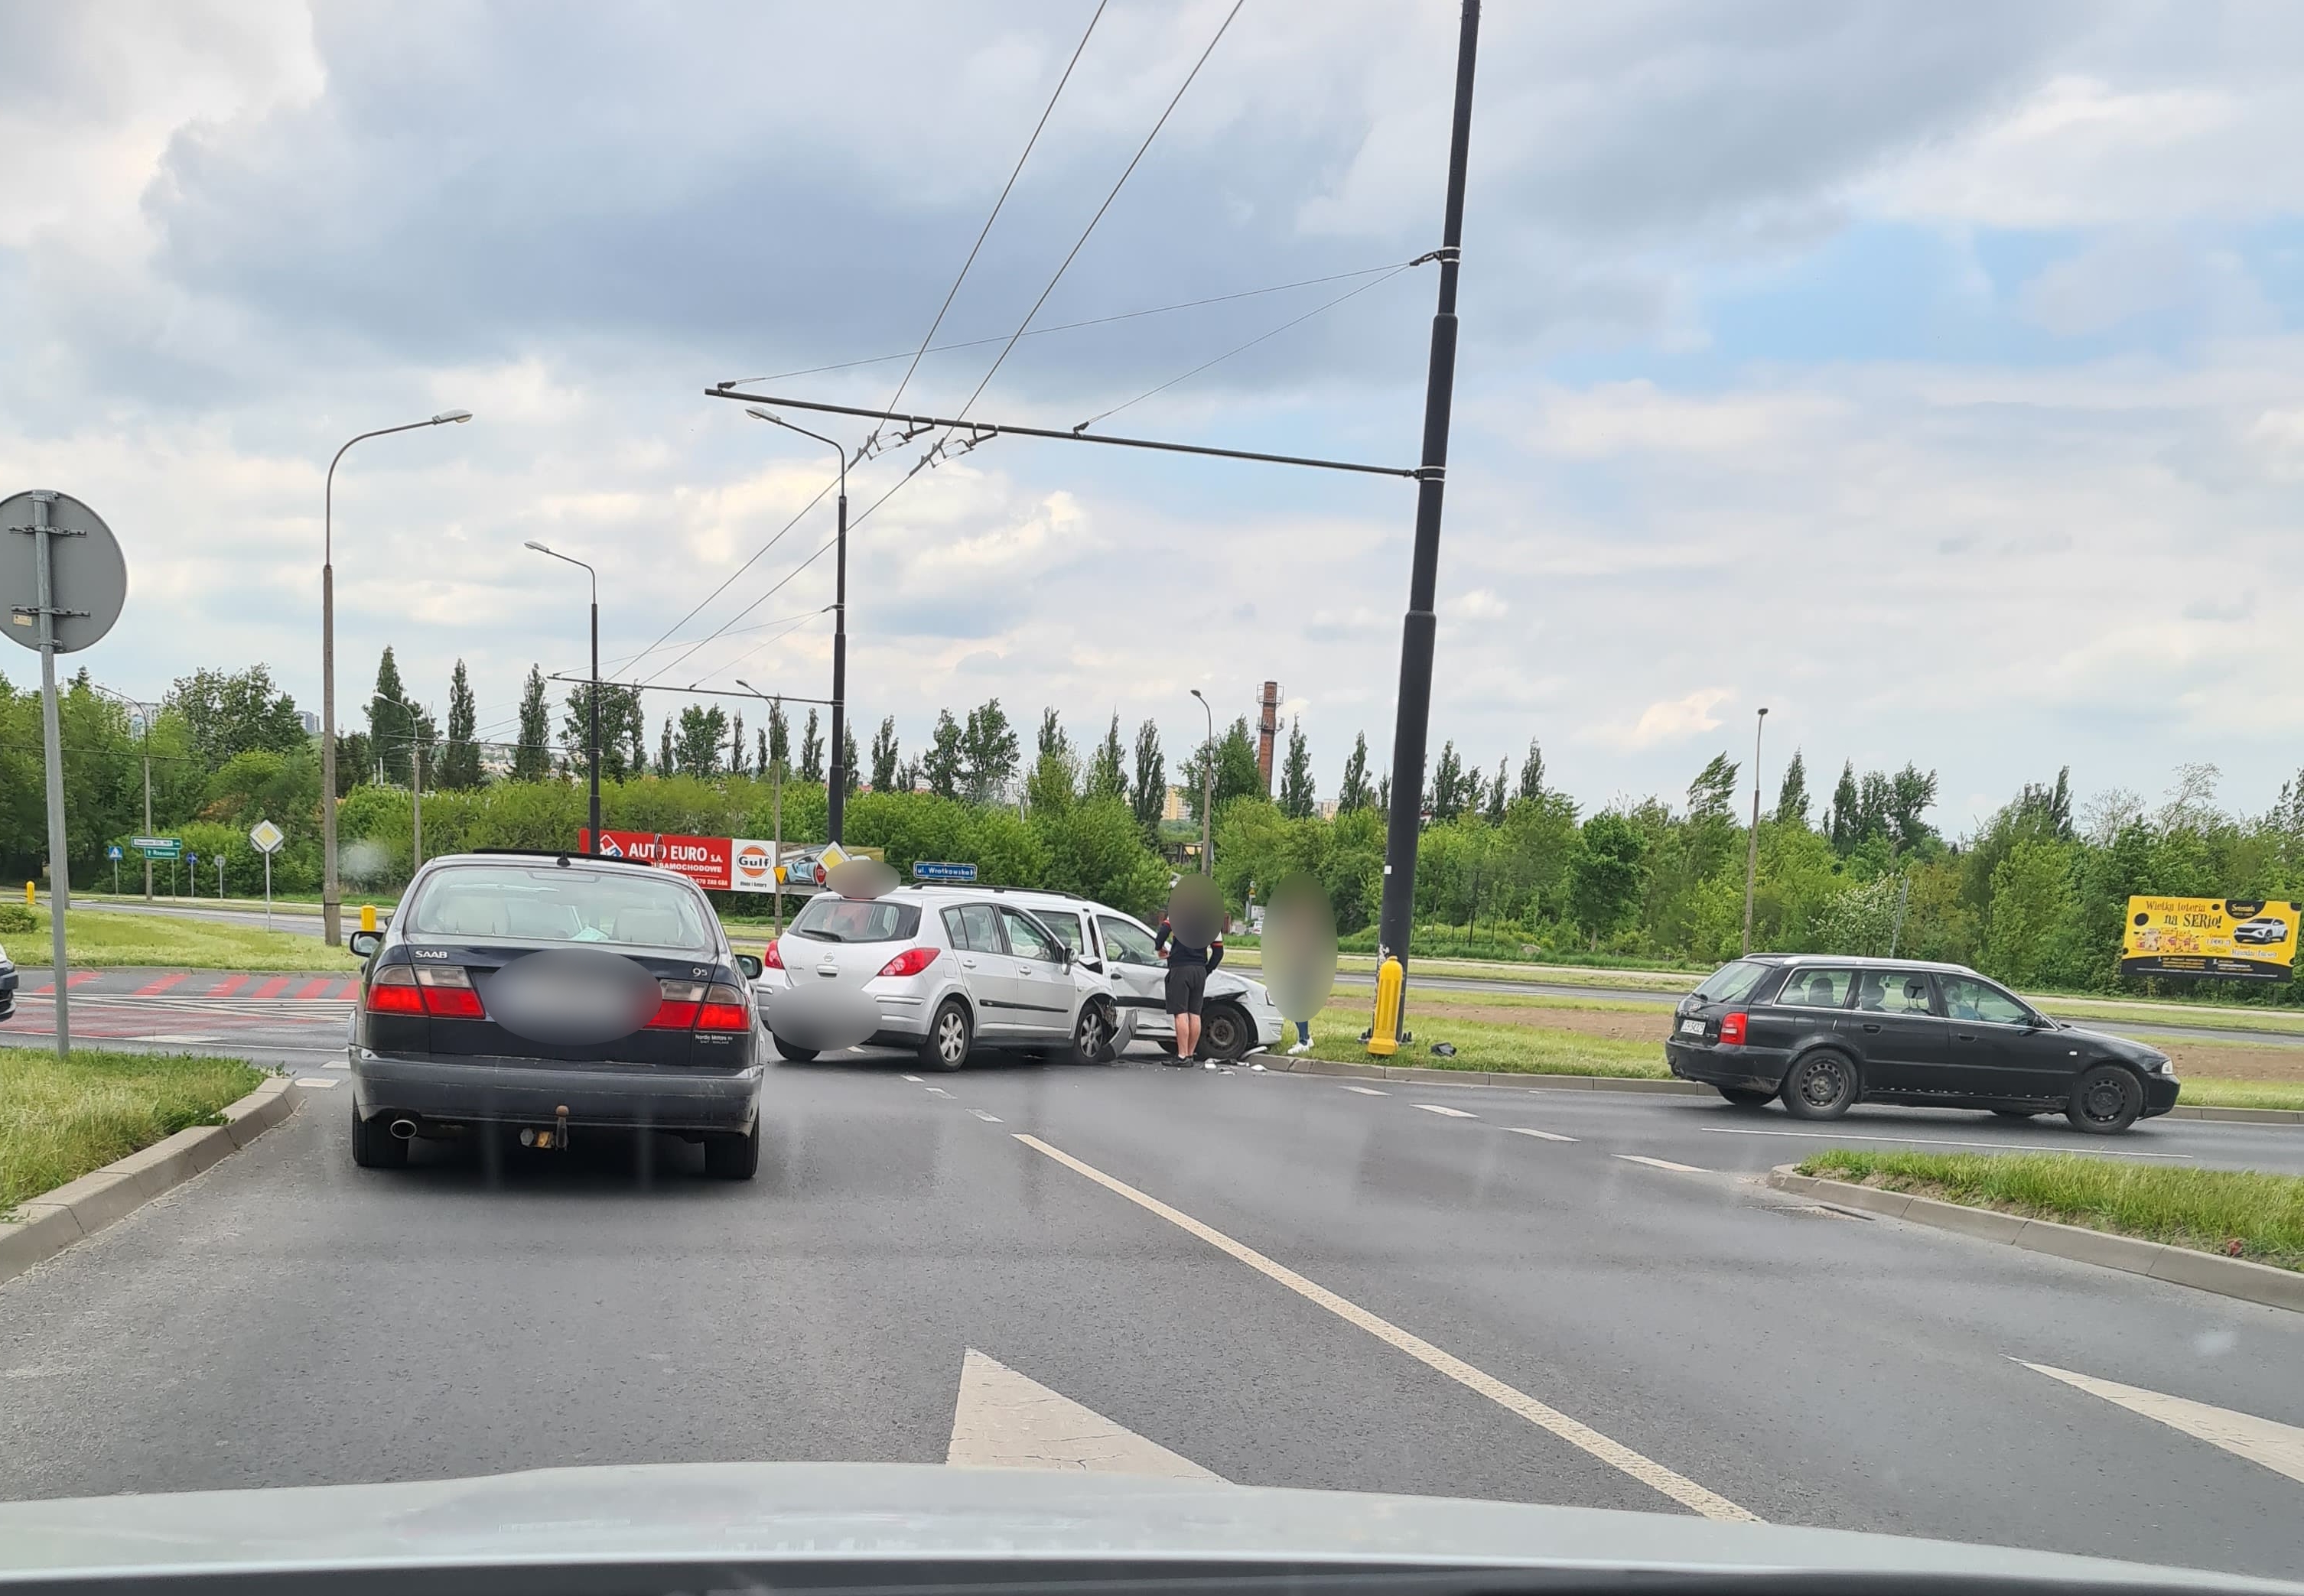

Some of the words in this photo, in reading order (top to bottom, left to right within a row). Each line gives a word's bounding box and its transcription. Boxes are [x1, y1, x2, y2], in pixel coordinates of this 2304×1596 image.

[670, 845, 708, 862] EURO
[738, 856, 770, 867] Gulf
[2146, 901, 2175, 912] Wielka
[2163, 915, 2178, 925] na
[415, 951, 448, 959] SAAB
